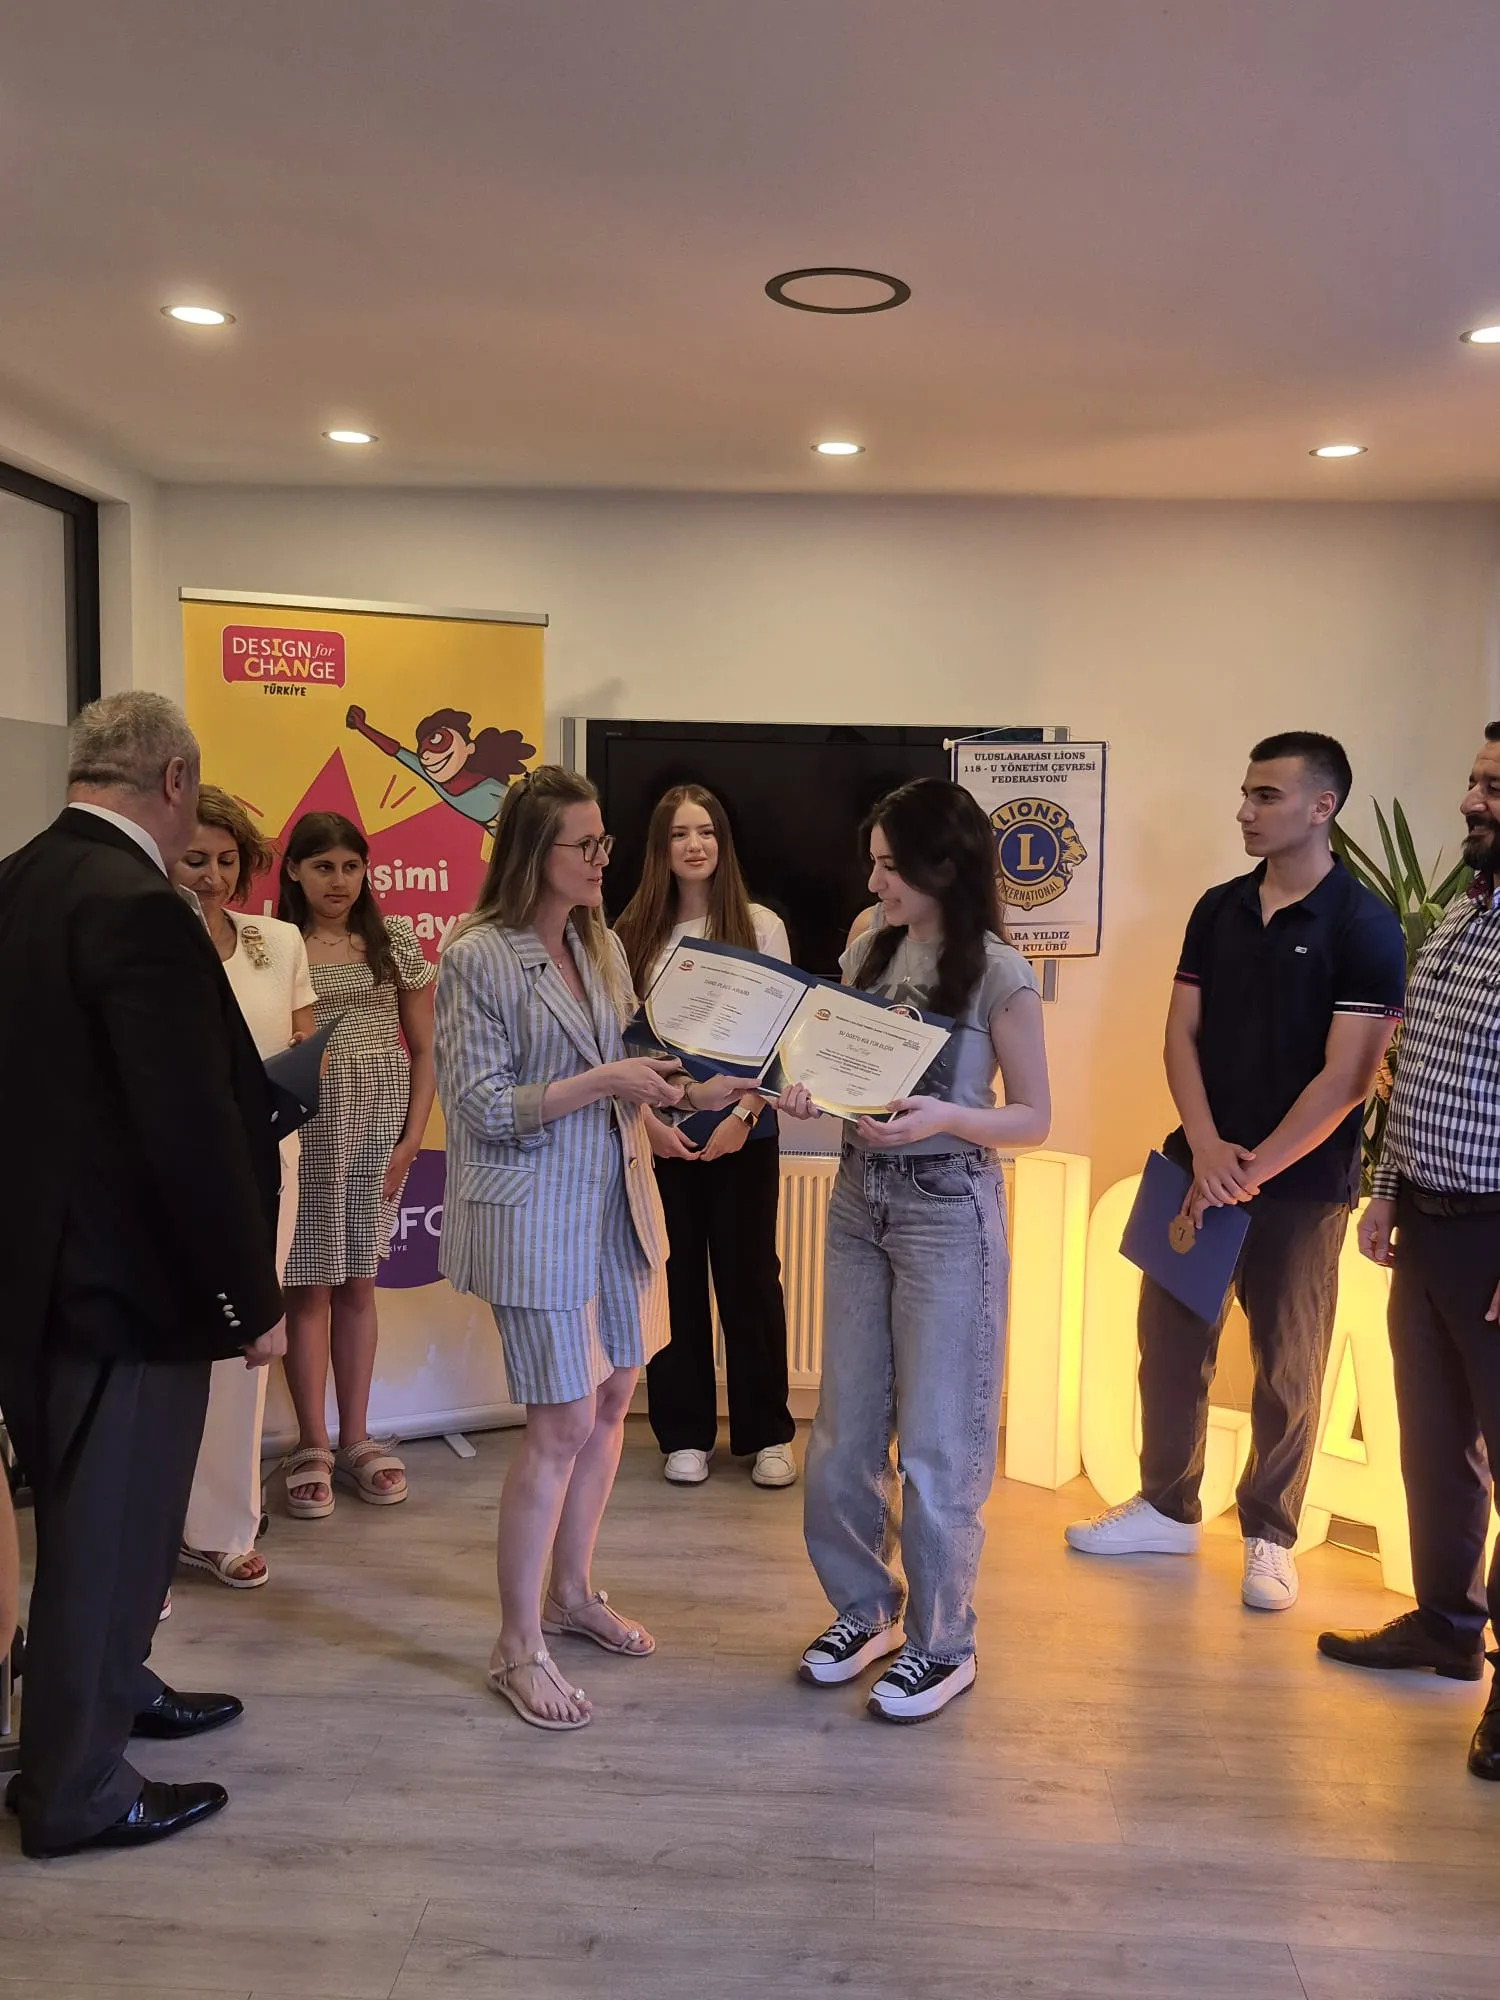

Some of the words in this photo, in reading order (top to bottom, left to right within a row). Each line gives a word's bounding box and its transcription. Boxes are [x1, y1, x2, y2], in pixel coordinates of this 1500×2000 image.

[232, 637, 312, 658] DESIGN
[312, 642, 336, 659] for
[243, 656, 336, 680] CHANGE
[263, 682, 307, 697] TÜRKİYE
[974, 751, 1051, 761] ULUSLARARASI
[1054, 750, 1086, 760] LİONS
[990, 764, 998, 773] U
[1000, 761, 1049, 773] YÖNETİM
[1051, 760, 1096, 774] ÇEVRESİ
[991, 774, 1068, 784] FEDERASYONU
[996, 801, 1063, 826] LIONS
[1016, 833, 1046, 871] L
[1032, 931, 1070, 941] YILDIZ
[1022, 940, 1067, 951] KULÜBÜ
